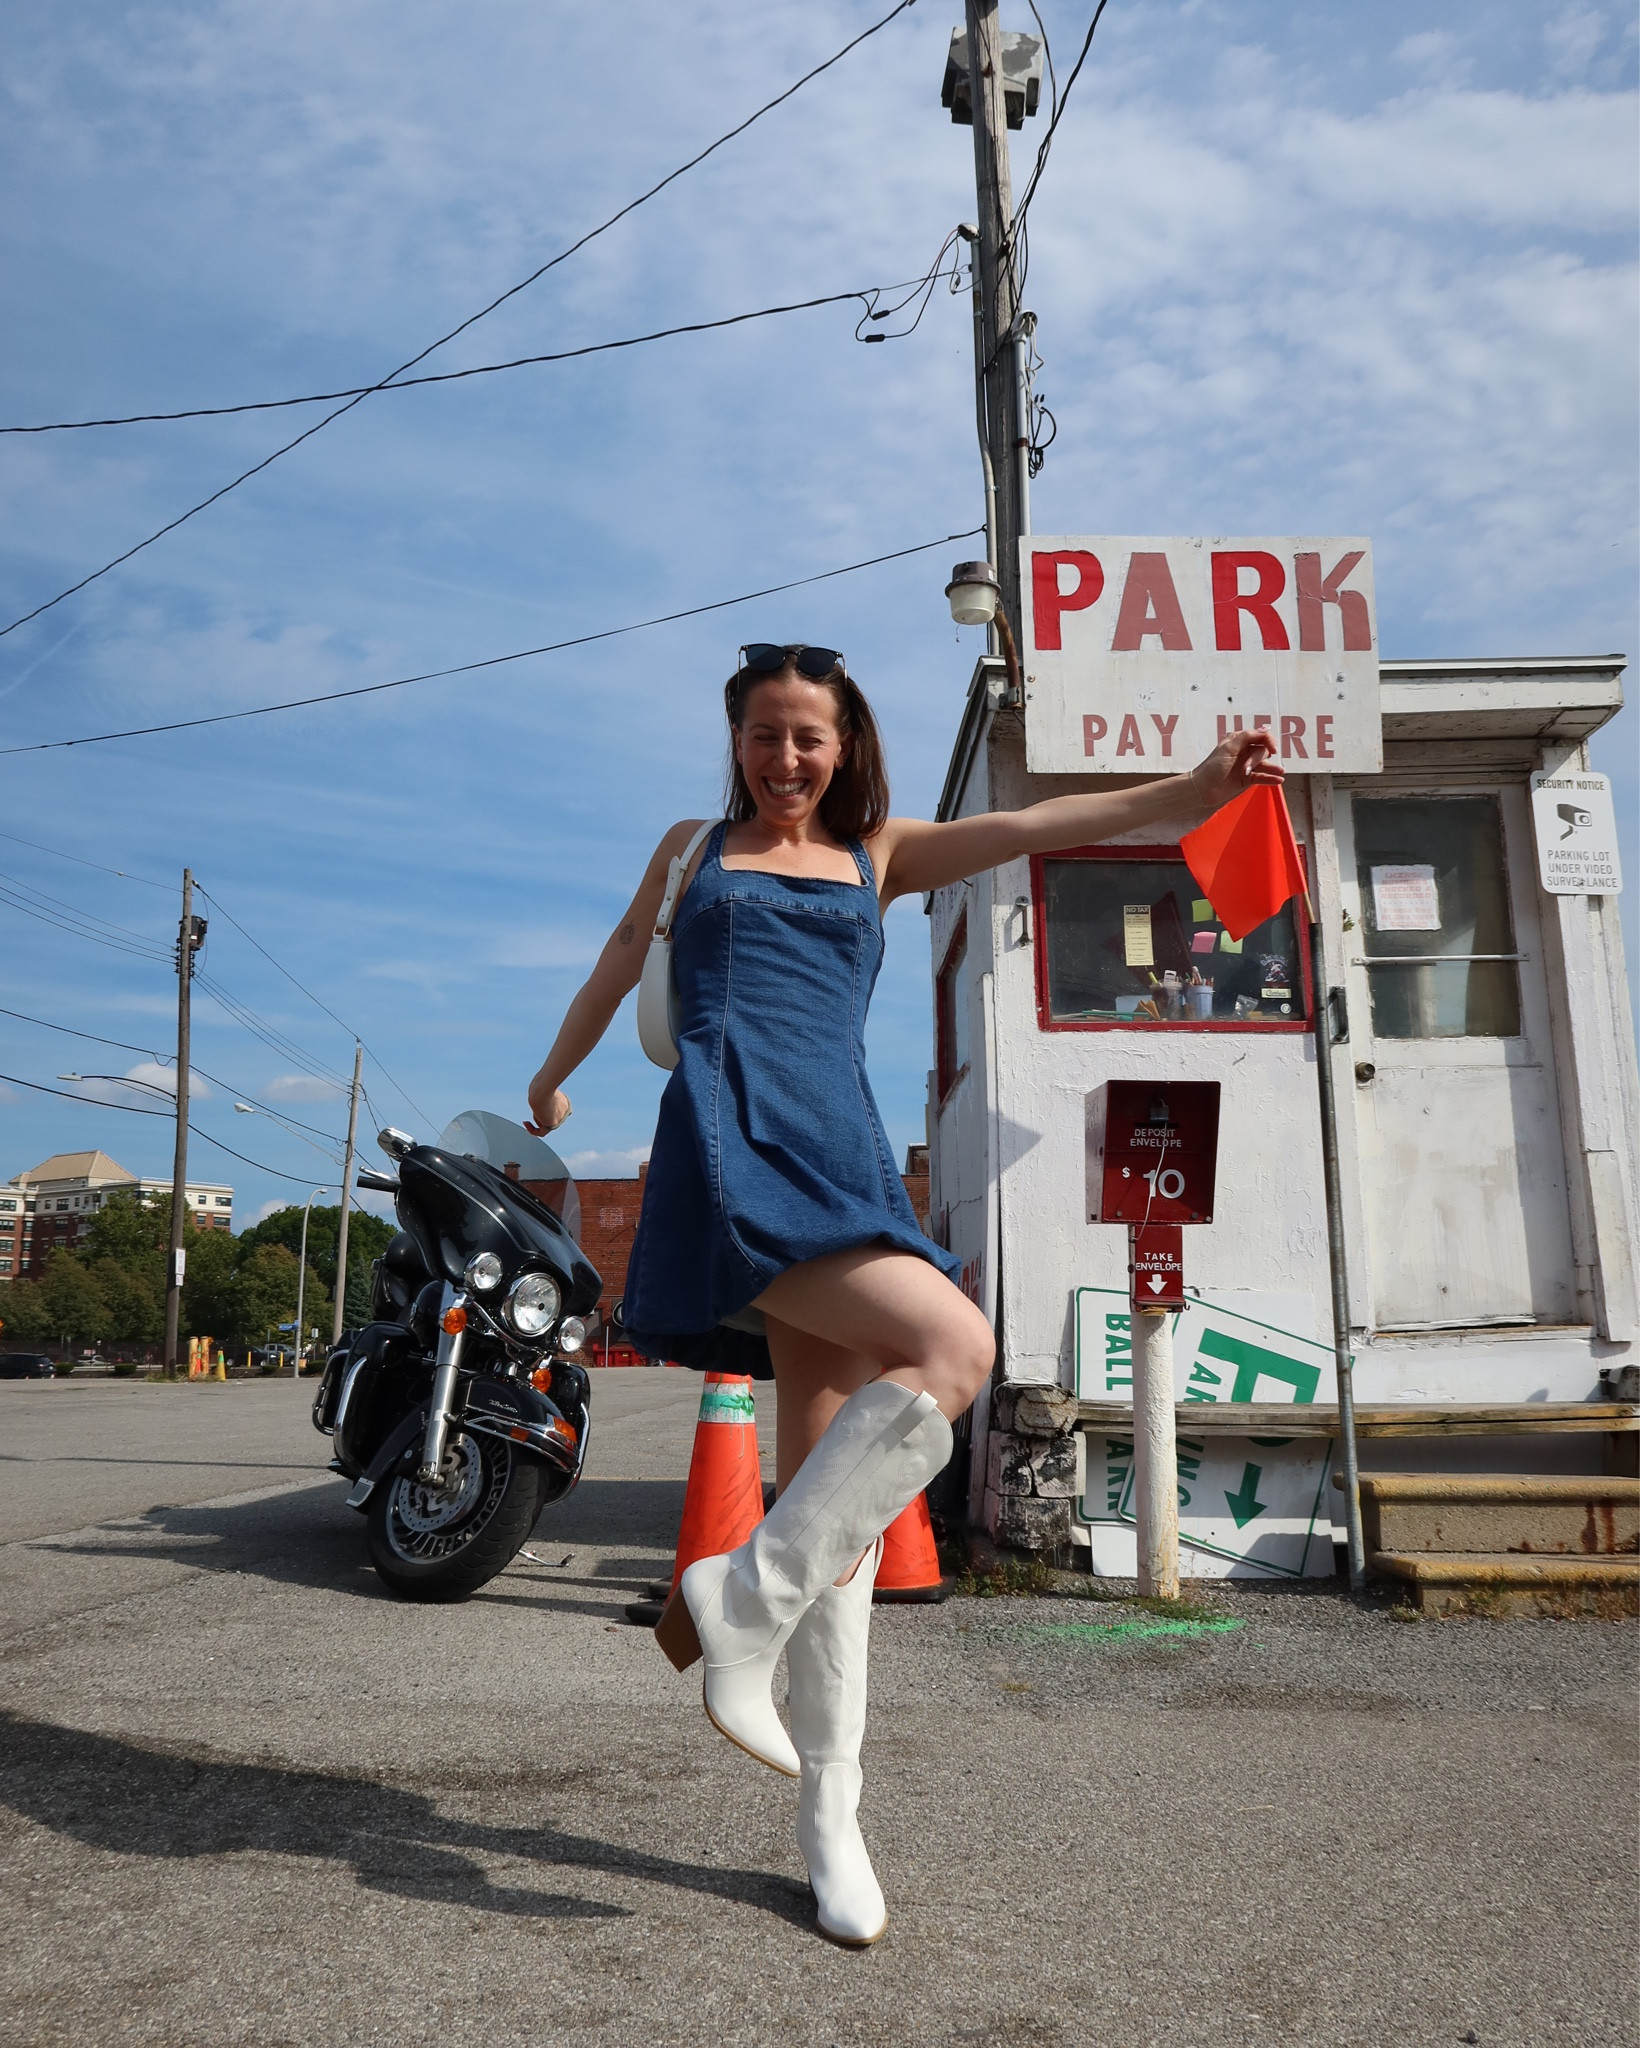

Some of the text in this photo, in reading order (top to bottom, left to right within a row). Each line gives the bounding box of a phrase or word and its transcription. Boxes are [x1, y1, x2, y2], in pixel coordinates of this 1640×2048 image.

[1031, 550, 1372, 652] PARK
[1082, 713, 1180, 757] PAY
[1536, 778, 1606, 791] SECURITY NOTICE
[1547, 849, 1611, 862] PARKING LOT
[1548, 863, 1613, 875] UNDER VIDEO
[1134, 1128, 1176, 1138] DEPOSIT
[1130, 1138, 1182, 1148] ENVELOPE
[1121, 1166, 1185, 1199] $ 10
[1144, 1252, 1173, 1262] TAKE
[1135, 1262, 1183, 1271] ENVELOPE
[1105, 1313, 1133, 1391] BALL
